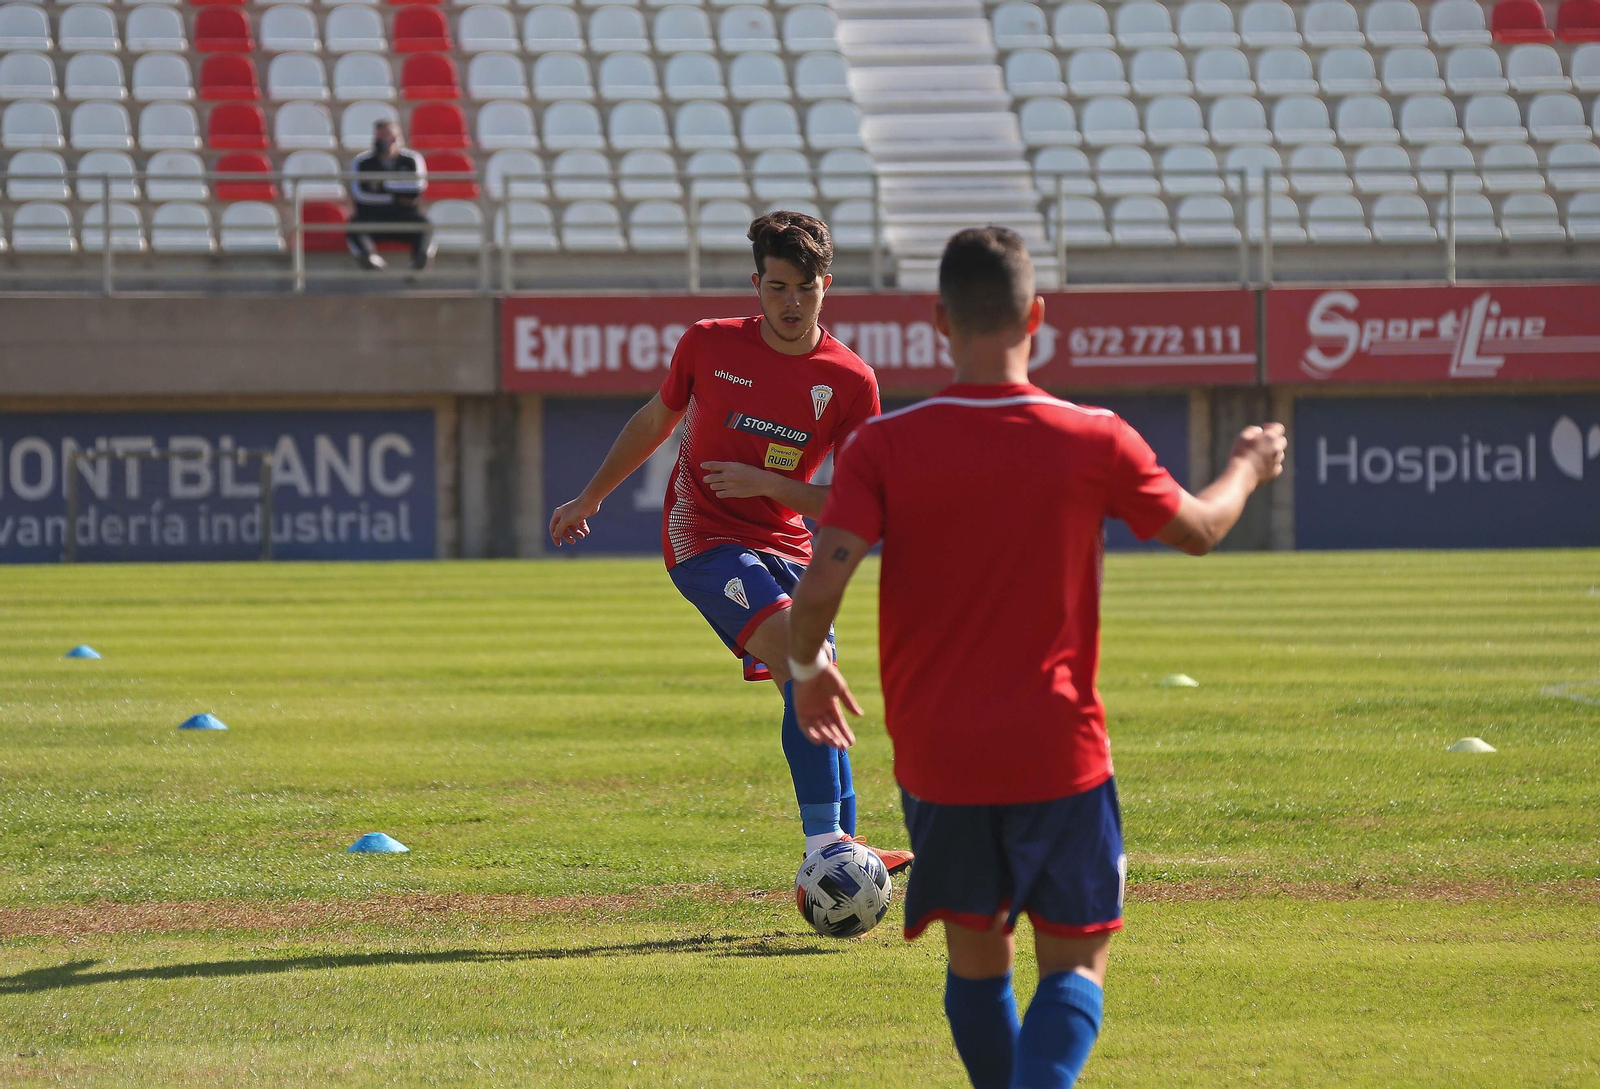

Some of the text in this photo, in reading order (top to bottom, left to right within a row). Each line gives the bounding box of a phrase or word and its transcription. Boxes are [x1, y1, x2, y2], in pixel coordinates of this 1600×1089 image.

[1069, 325, 1241, 355] 672 772 111
[714, 369, 753, 388] uhlsport
[743, 417, 807, 442] STOP-FLUID
[767, 455, 796, 467] RUBIX
[770, 447, 791, 456] Powered
[1316, 433, 1538, 494] Hospital
[0, 433, 415, 502] ONT BLANC
[200, 503, 413, 546] industrial
